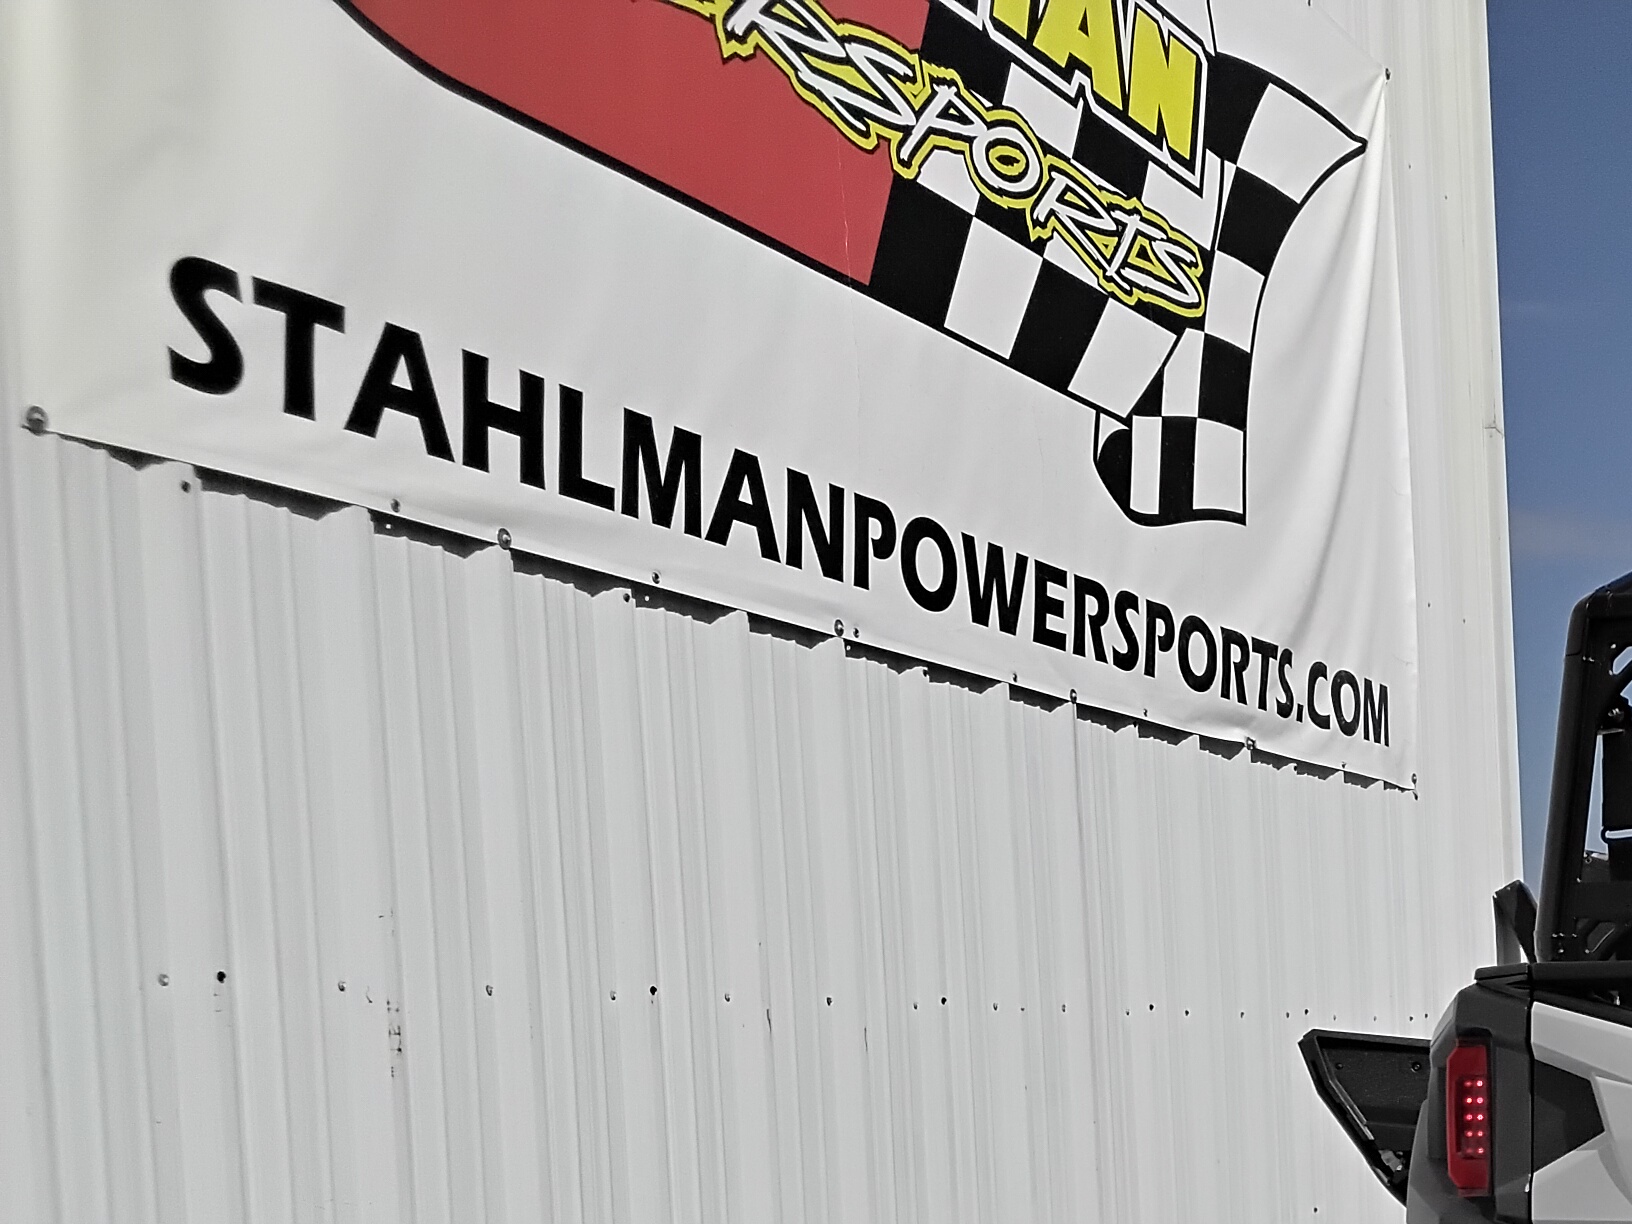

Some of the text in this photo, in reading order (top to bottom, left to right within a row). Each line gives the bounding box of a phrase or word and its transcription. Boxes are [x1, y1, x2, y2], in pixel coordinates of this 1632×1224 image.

[722, 0, 1205, 310] RSPORTS
[984, 0, 1203, 168] AN
[168, 256, 1391, 748] STAHLMANPOWERSPORTS.COM
